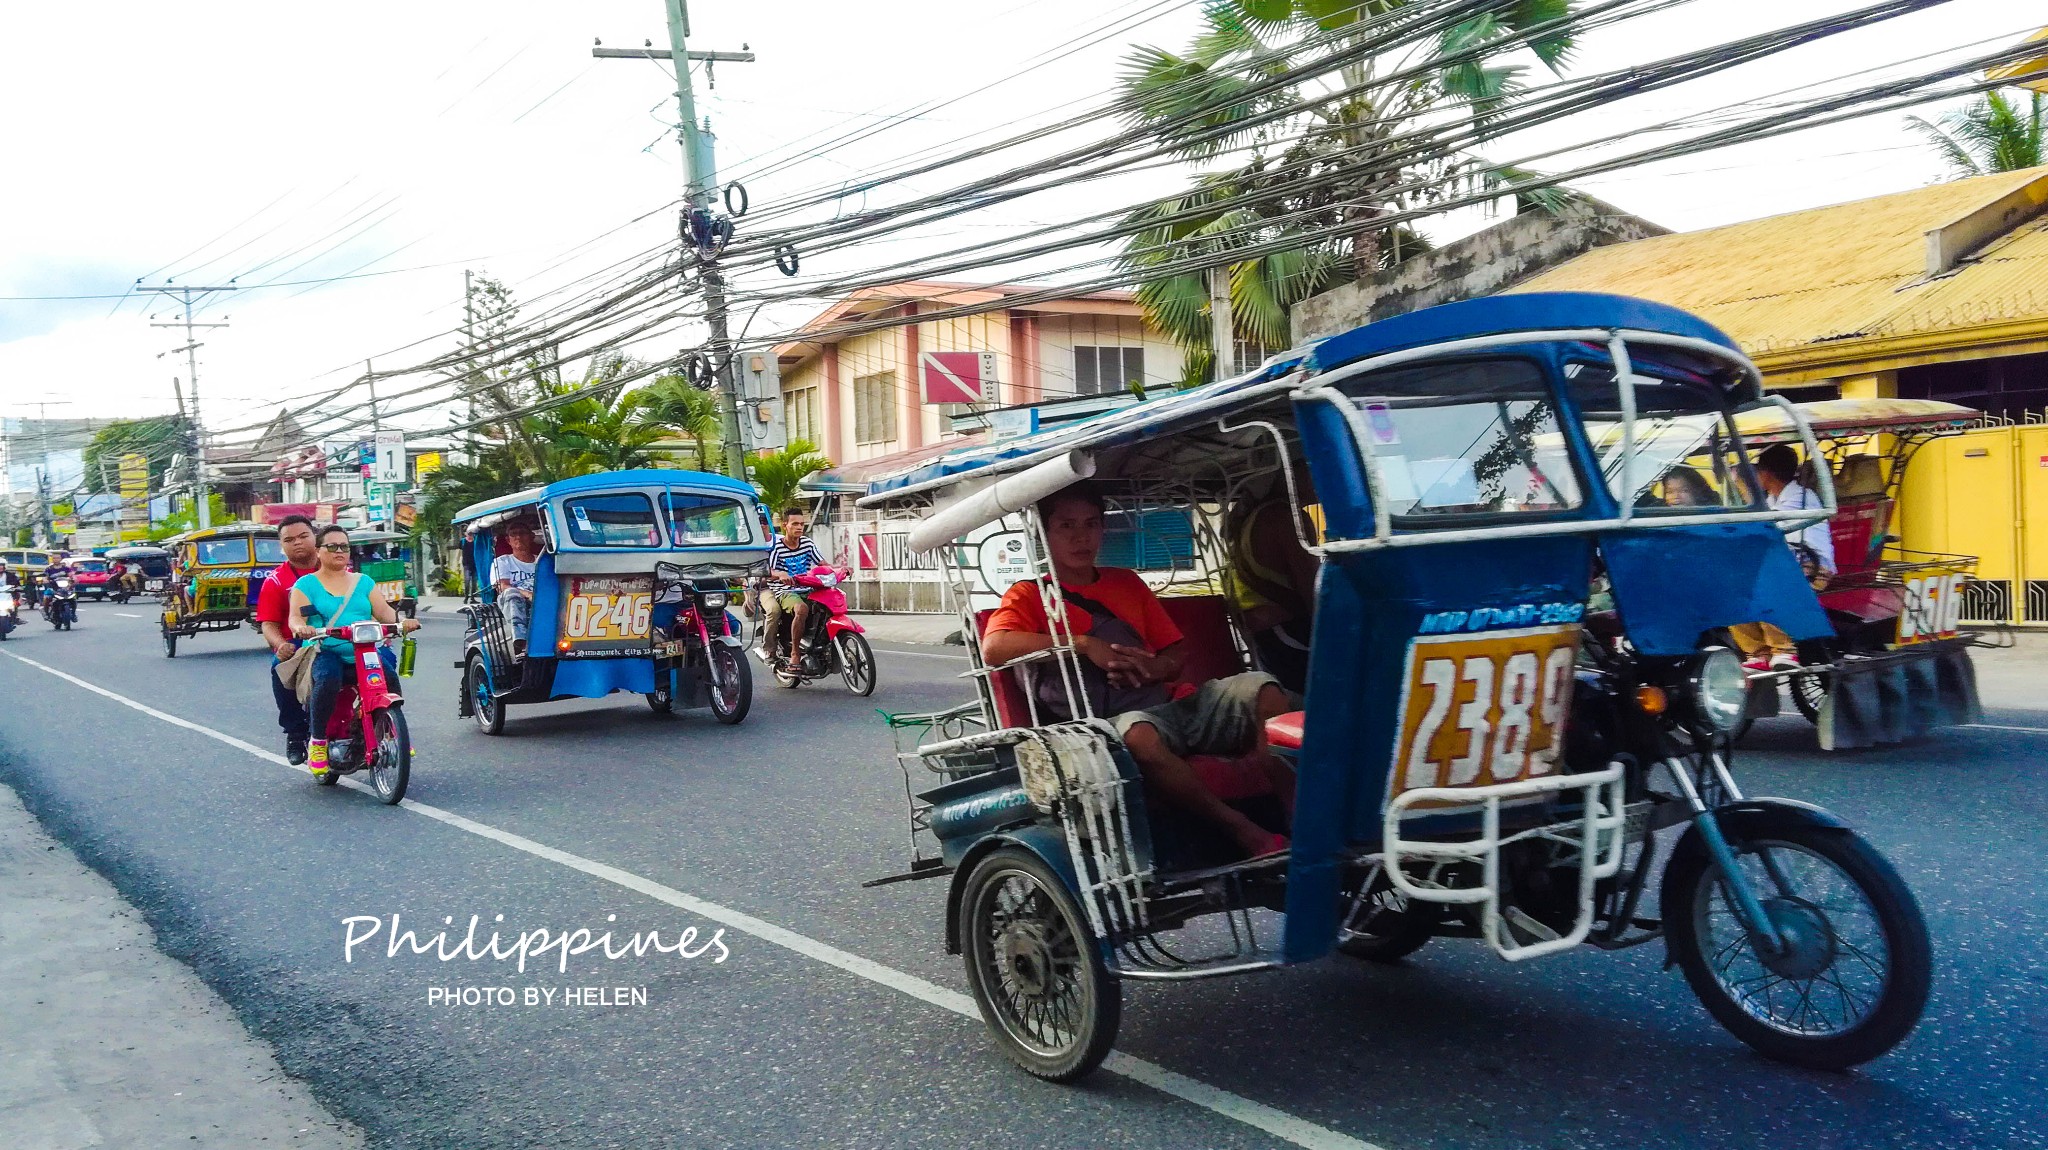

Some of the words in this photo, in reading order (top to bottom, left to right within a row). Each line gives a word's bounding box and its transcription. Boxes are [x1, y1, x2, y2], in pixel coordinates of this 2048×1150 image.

[983, 354, 992, 375] DIVE
[386, 450, 393, 470] 1
[383, 471, 398, 480] KM
[567, 595, 652, 637] 0246
[1405, 646, 1574, 790] 2389
